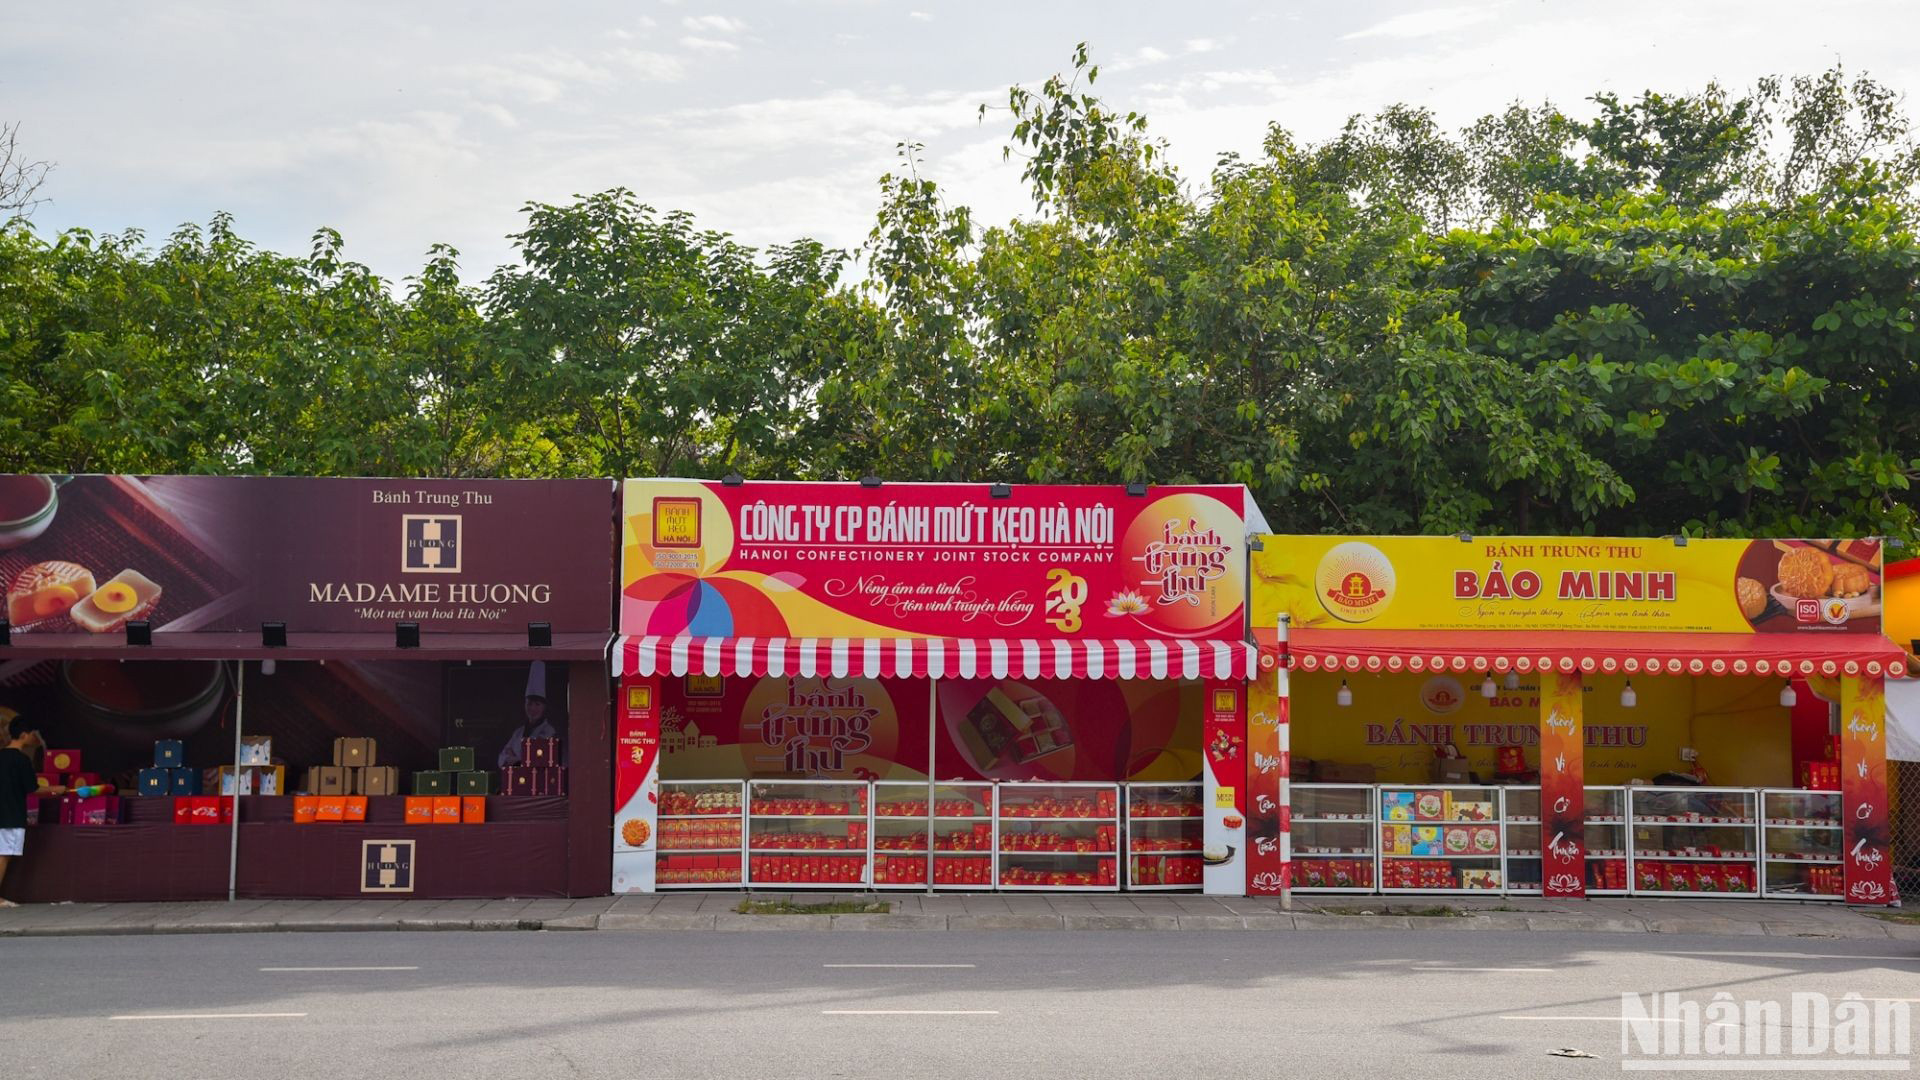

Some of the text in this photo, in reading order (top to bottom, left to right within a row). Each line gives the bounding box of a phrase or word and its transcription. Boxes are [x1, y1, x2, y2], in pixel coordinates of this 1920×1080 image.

[373, 490, 493, 507] Bánh Trung Thu
[663, 534, 675, 542] HÀ
[740, 500, 1114, 550] CÔNG TY CP BÁNH MỨT KẸO HÀ NỘI
[1163, 517, 1222, 545] bánh
[408, 538, 456, 549] HUONG
[740, 550, 1114, 562] HANOI CONFECTIONERY JOINT STOCK COMPANY
[1486, 543, 1643, 559] BÁNH TRUNG THU
[1132, 541, 1232, 579] trung
[309, 583, 552, 604] MADAME HUONG
[824, 575, 892, 606] Nồng
[892, 581, 912, 595] ấm
[916, 582, 935, 595] ân
[1141, 567, 1206, 606] thu
[1454, 560, 1676, 601] BẢO MINH
[354, 608, 386, 620] “Một
[387, 608, 406, 619] nét
[432, 608, 454, 619] hoá
[458, 608, 476, 619] Hà
[479, 608, 507, 620] Nội”
[954, 598, 998, 622] truyền
[994, 590, 1034, 626] thống
[1355, 596, 1376, 607] MINH
[1800, 605, 1817, 614] ISO
[788, 678, 866, 708] bánh
[743, 703, 880, 753] trung
[1366, 718, 1648, 747] BÁNH TRUN THU
[1555, 752, 1566, 774] Vị
[1857, 758, 1868, 780] Vị
[1548, 831, 1580, 865] Truyền
[1851, 837, 1883, 872] Truyền
